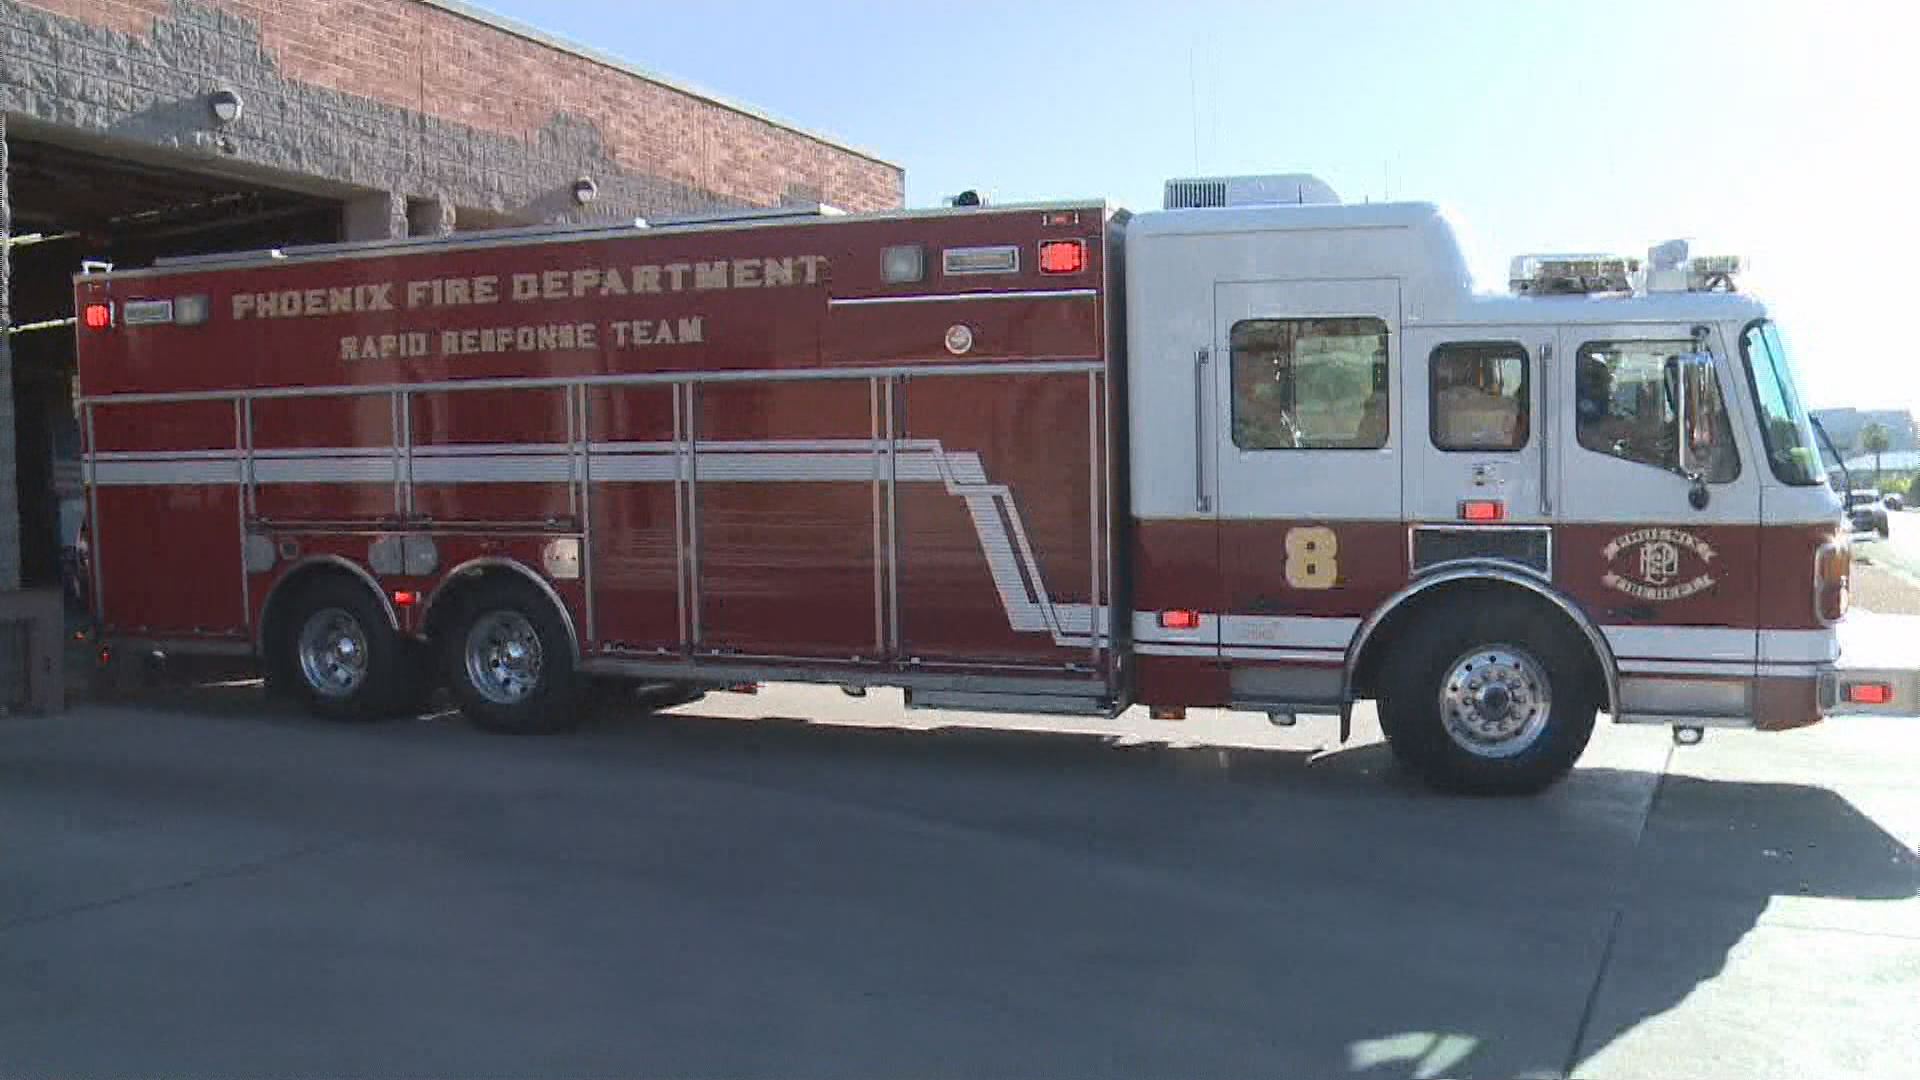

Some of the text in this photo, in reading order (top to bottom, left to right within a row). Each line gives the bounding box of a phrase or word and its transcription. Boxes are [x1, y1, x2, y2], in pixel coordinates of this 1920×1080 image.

[231, 254, 827, 320] PHOENIX FIRE DEPARTMENT
[341, 331, 427, 360] RAPID
[611, 315, 704, 346] TEAM
[1284, 526, 1338, 589] 8
